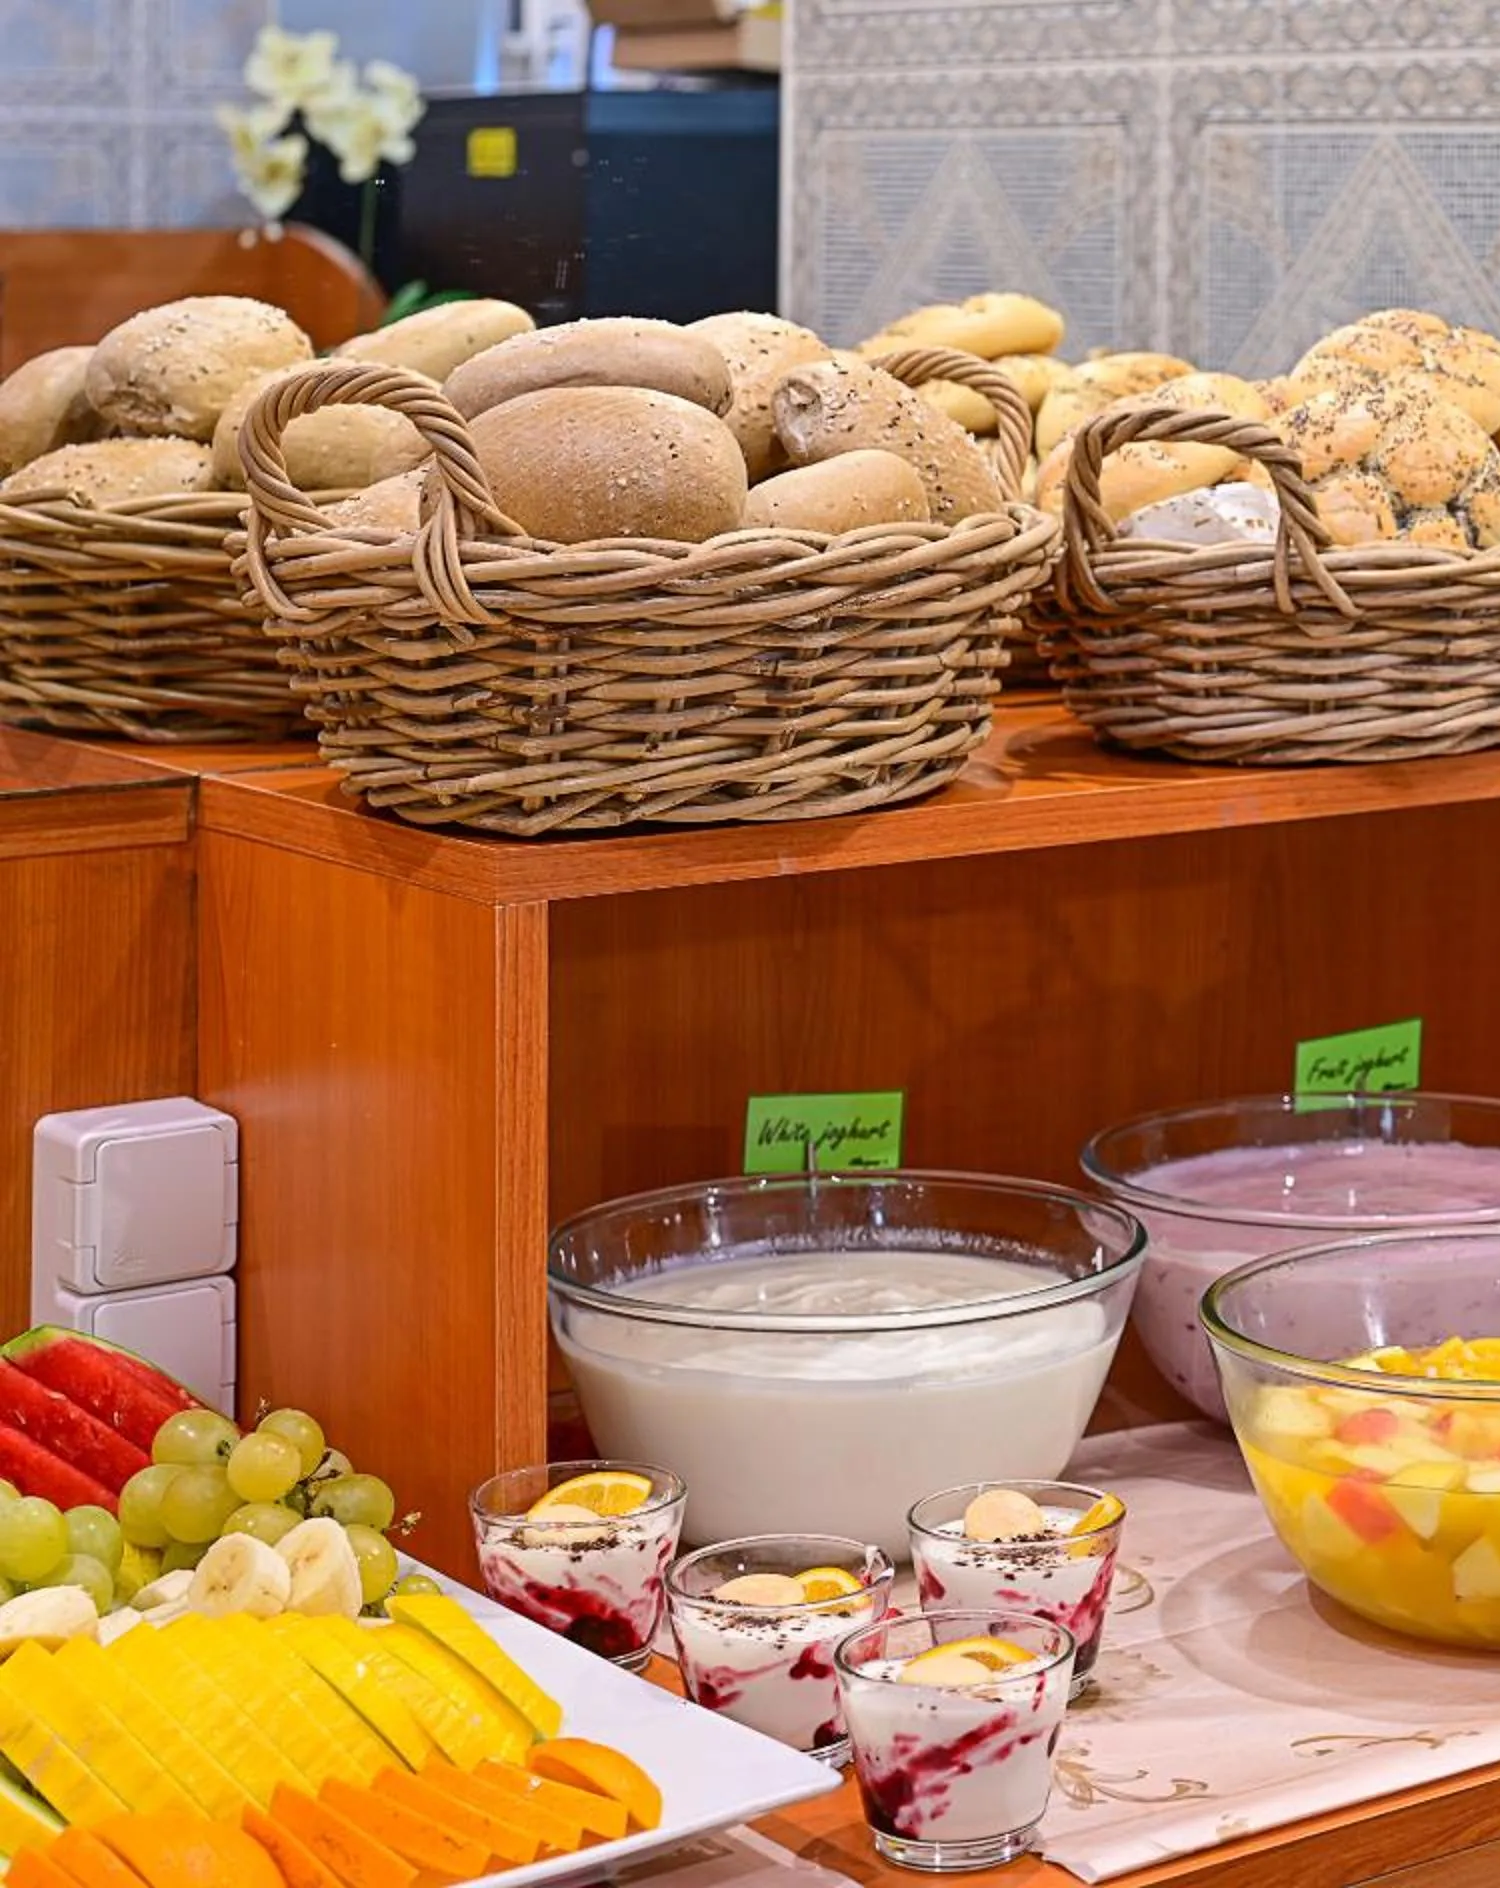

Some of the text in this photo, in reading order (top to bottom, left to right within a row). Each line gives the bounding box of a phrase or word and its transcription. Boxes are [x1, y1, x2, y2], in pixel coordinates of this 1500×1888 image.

[1306, 1055, 1349, 1085] Fruit
[757, 1115, 892, 1151] White joghurt
